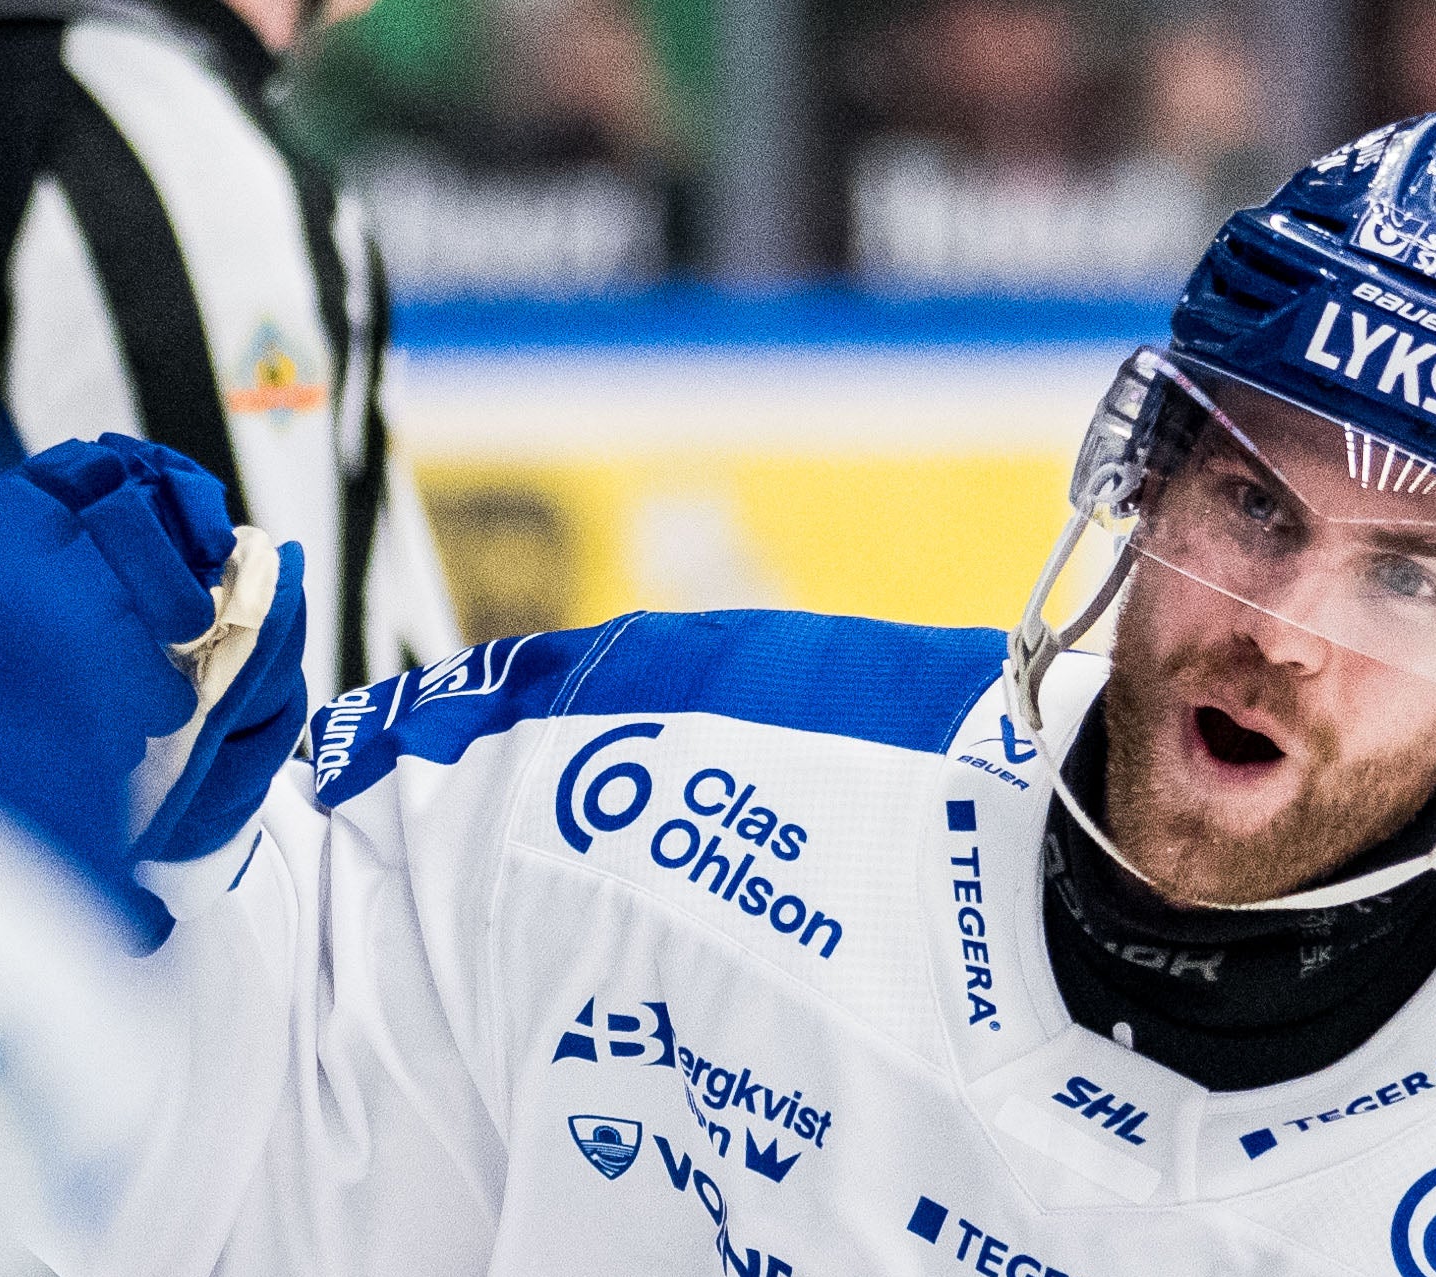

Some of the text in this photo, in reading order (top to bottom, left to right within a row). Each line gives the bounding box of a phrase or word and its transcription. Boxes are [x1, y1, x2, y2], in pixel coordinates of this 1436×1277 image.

[684, 769, 807, 861] Clas
[651, 820, 843, 959] Ohlson
[678, 1046, 832, 1149] ergkvist
[1052, 1076, 1145, 1145] SHL
